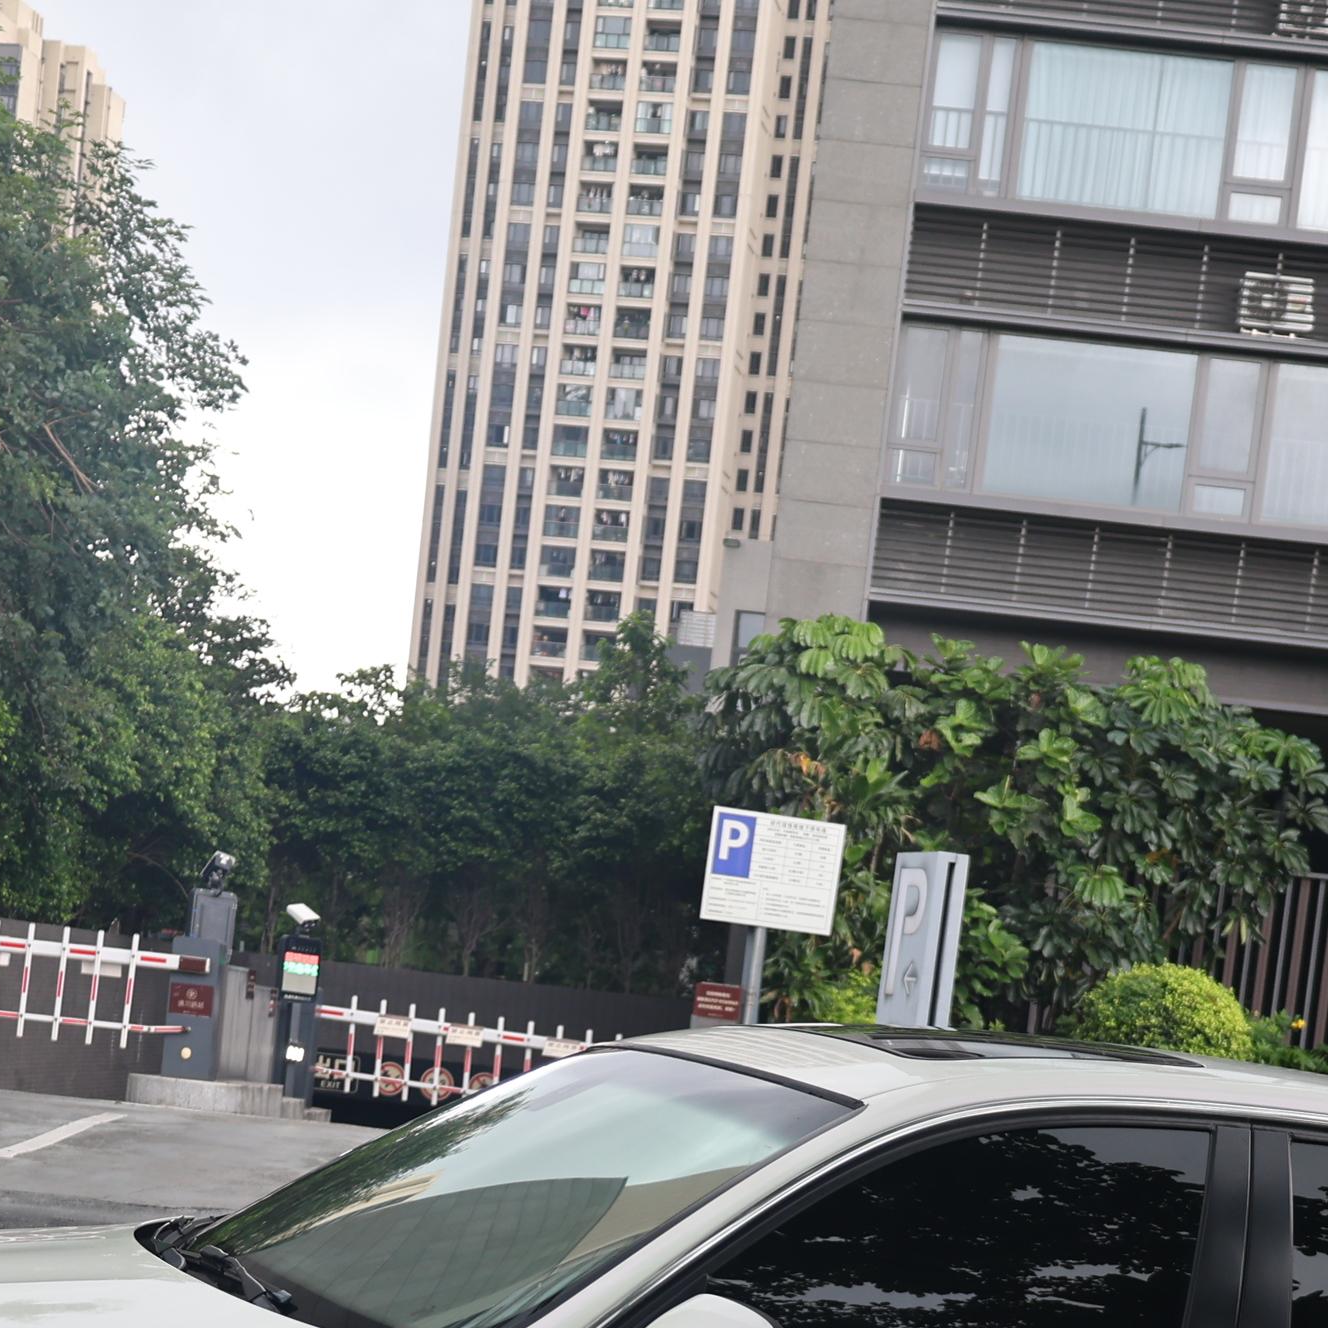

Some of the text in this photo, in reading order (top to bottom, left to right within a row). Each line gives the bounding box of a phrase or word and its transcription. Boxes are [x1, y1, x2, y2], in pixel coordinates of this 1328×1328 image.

[718, 819, 750, 861] P
[884, 867, 928, 996] P
[320, 1080, 341, 1089] EXIT
